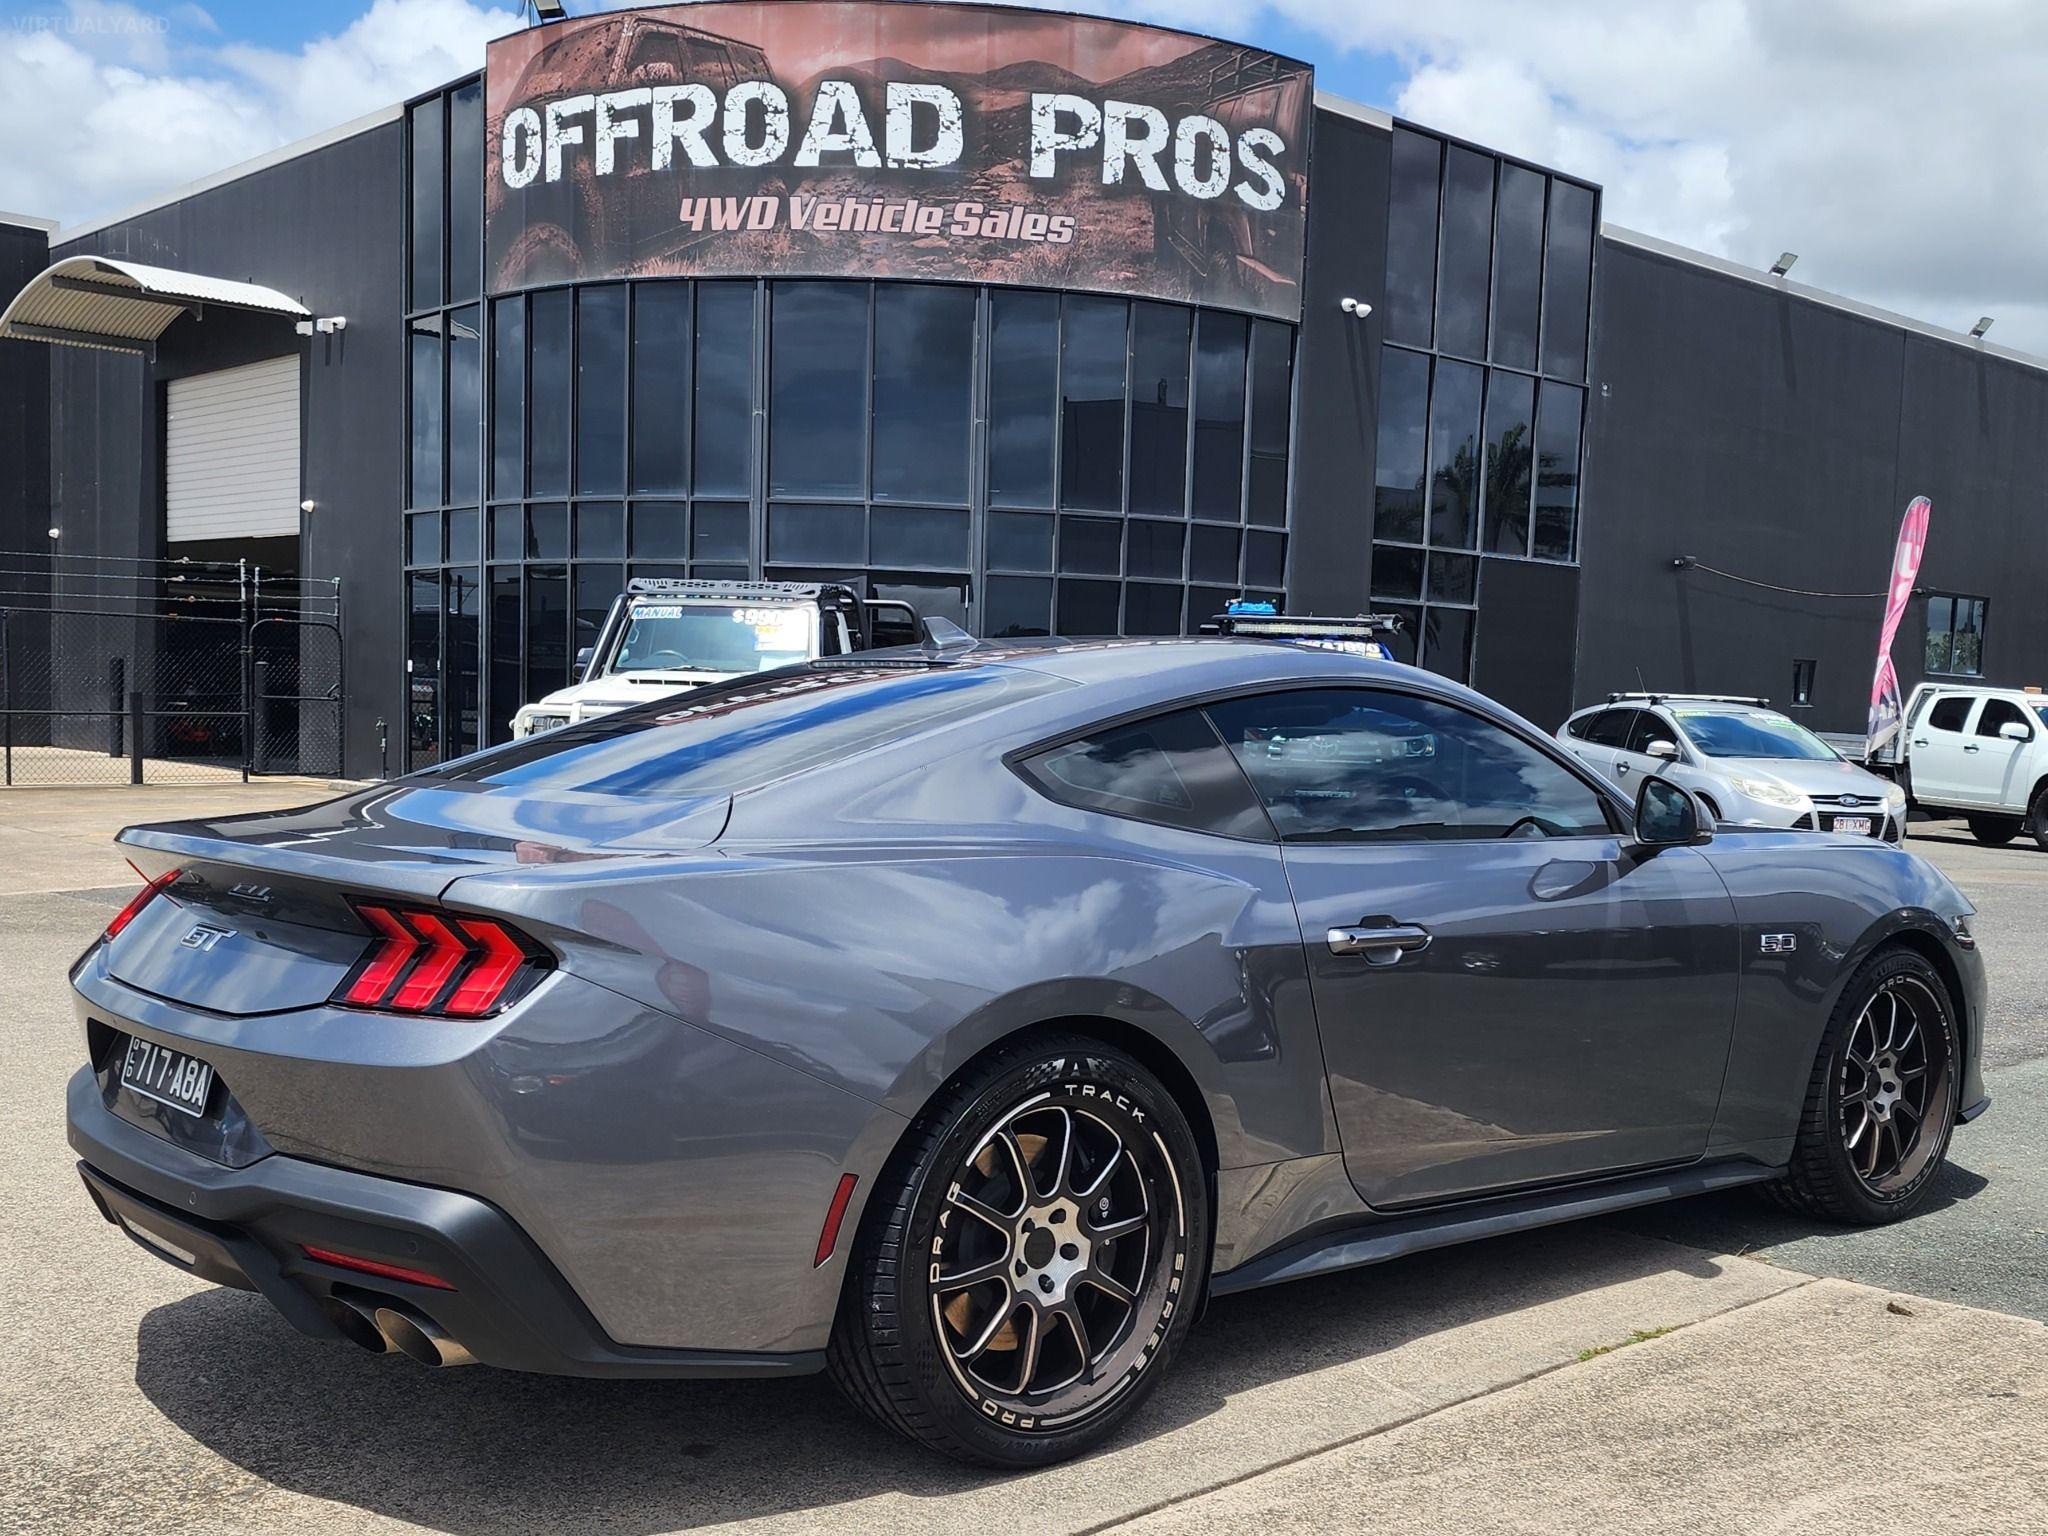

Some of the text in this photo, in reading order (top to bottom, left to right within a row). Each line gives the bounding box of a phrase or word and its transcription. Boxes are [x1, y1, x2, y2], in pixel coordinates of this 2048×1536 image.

[503, 81, 1286, 211] OFFROAD PROS
[680, 196, 1077, 244] 4WD Vehicle Sales
[632, 606, 683, 619] MANUAL
[180, 921, 238, 951] GT
[1761, 934, 1796, 952] 5.0
[1065, 1084, 1145, 1124] TRACK
[930, 1181, 962, 1284] DRAG
[1131, 1252, 1185, 1371] SERIES
[982, 1400, 1035, 1429] PRO
